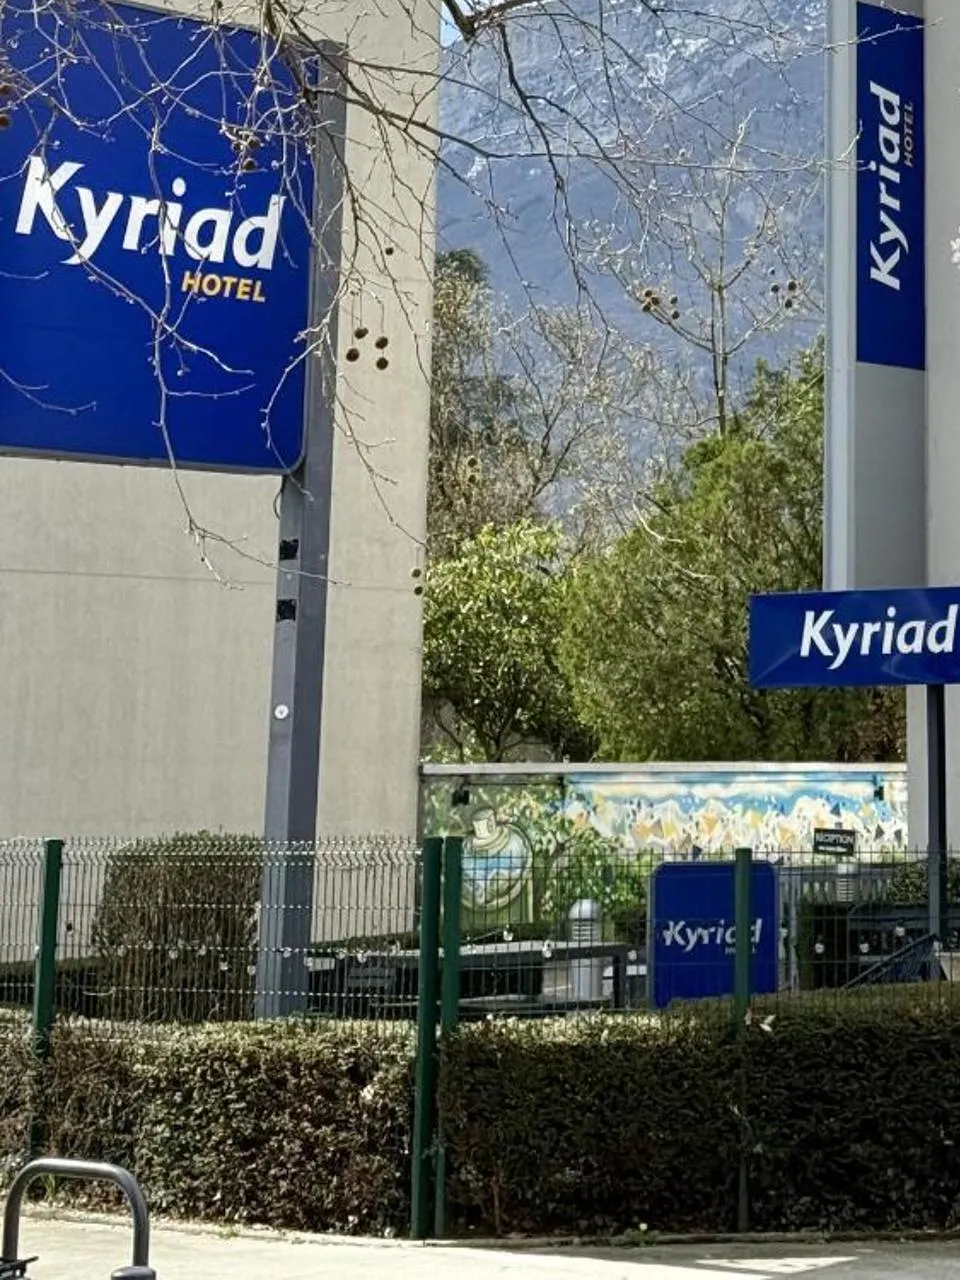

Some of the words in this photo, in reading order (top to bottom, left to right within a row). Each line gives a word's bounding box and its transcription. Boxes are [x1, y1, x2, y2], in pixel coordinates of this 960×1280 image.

[904, 102, 914, 168] HOTEL
[15, 155, 286, 270] Kyriad
[870, 80, 909, 291] Kyriad
[182, 271, 265, 302] HOTEL
[800, 604, 959, 670] Kyriad
